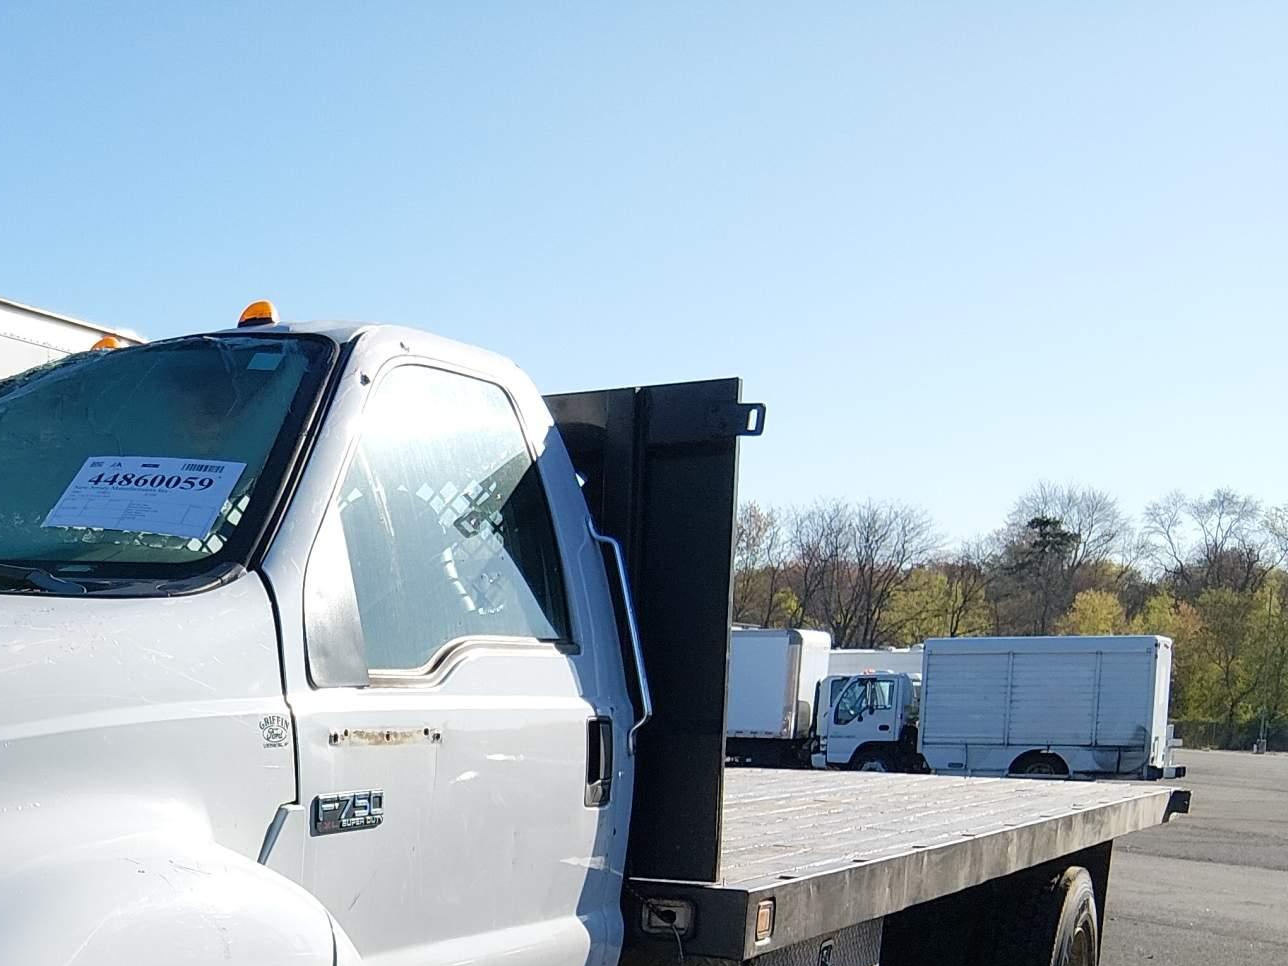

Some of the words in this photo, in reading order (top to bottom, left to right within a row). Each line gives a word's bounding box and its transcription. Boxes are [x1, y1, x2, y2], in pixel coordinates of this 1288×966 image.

[88, 472, 214, 491] 44860059
[259, 715, 289, 730] GRIFFIN
[266, 728, 283, 740] Ford
[341, 817, 365, 828] SUPER
[366, 815, 384, 825] DUTY
